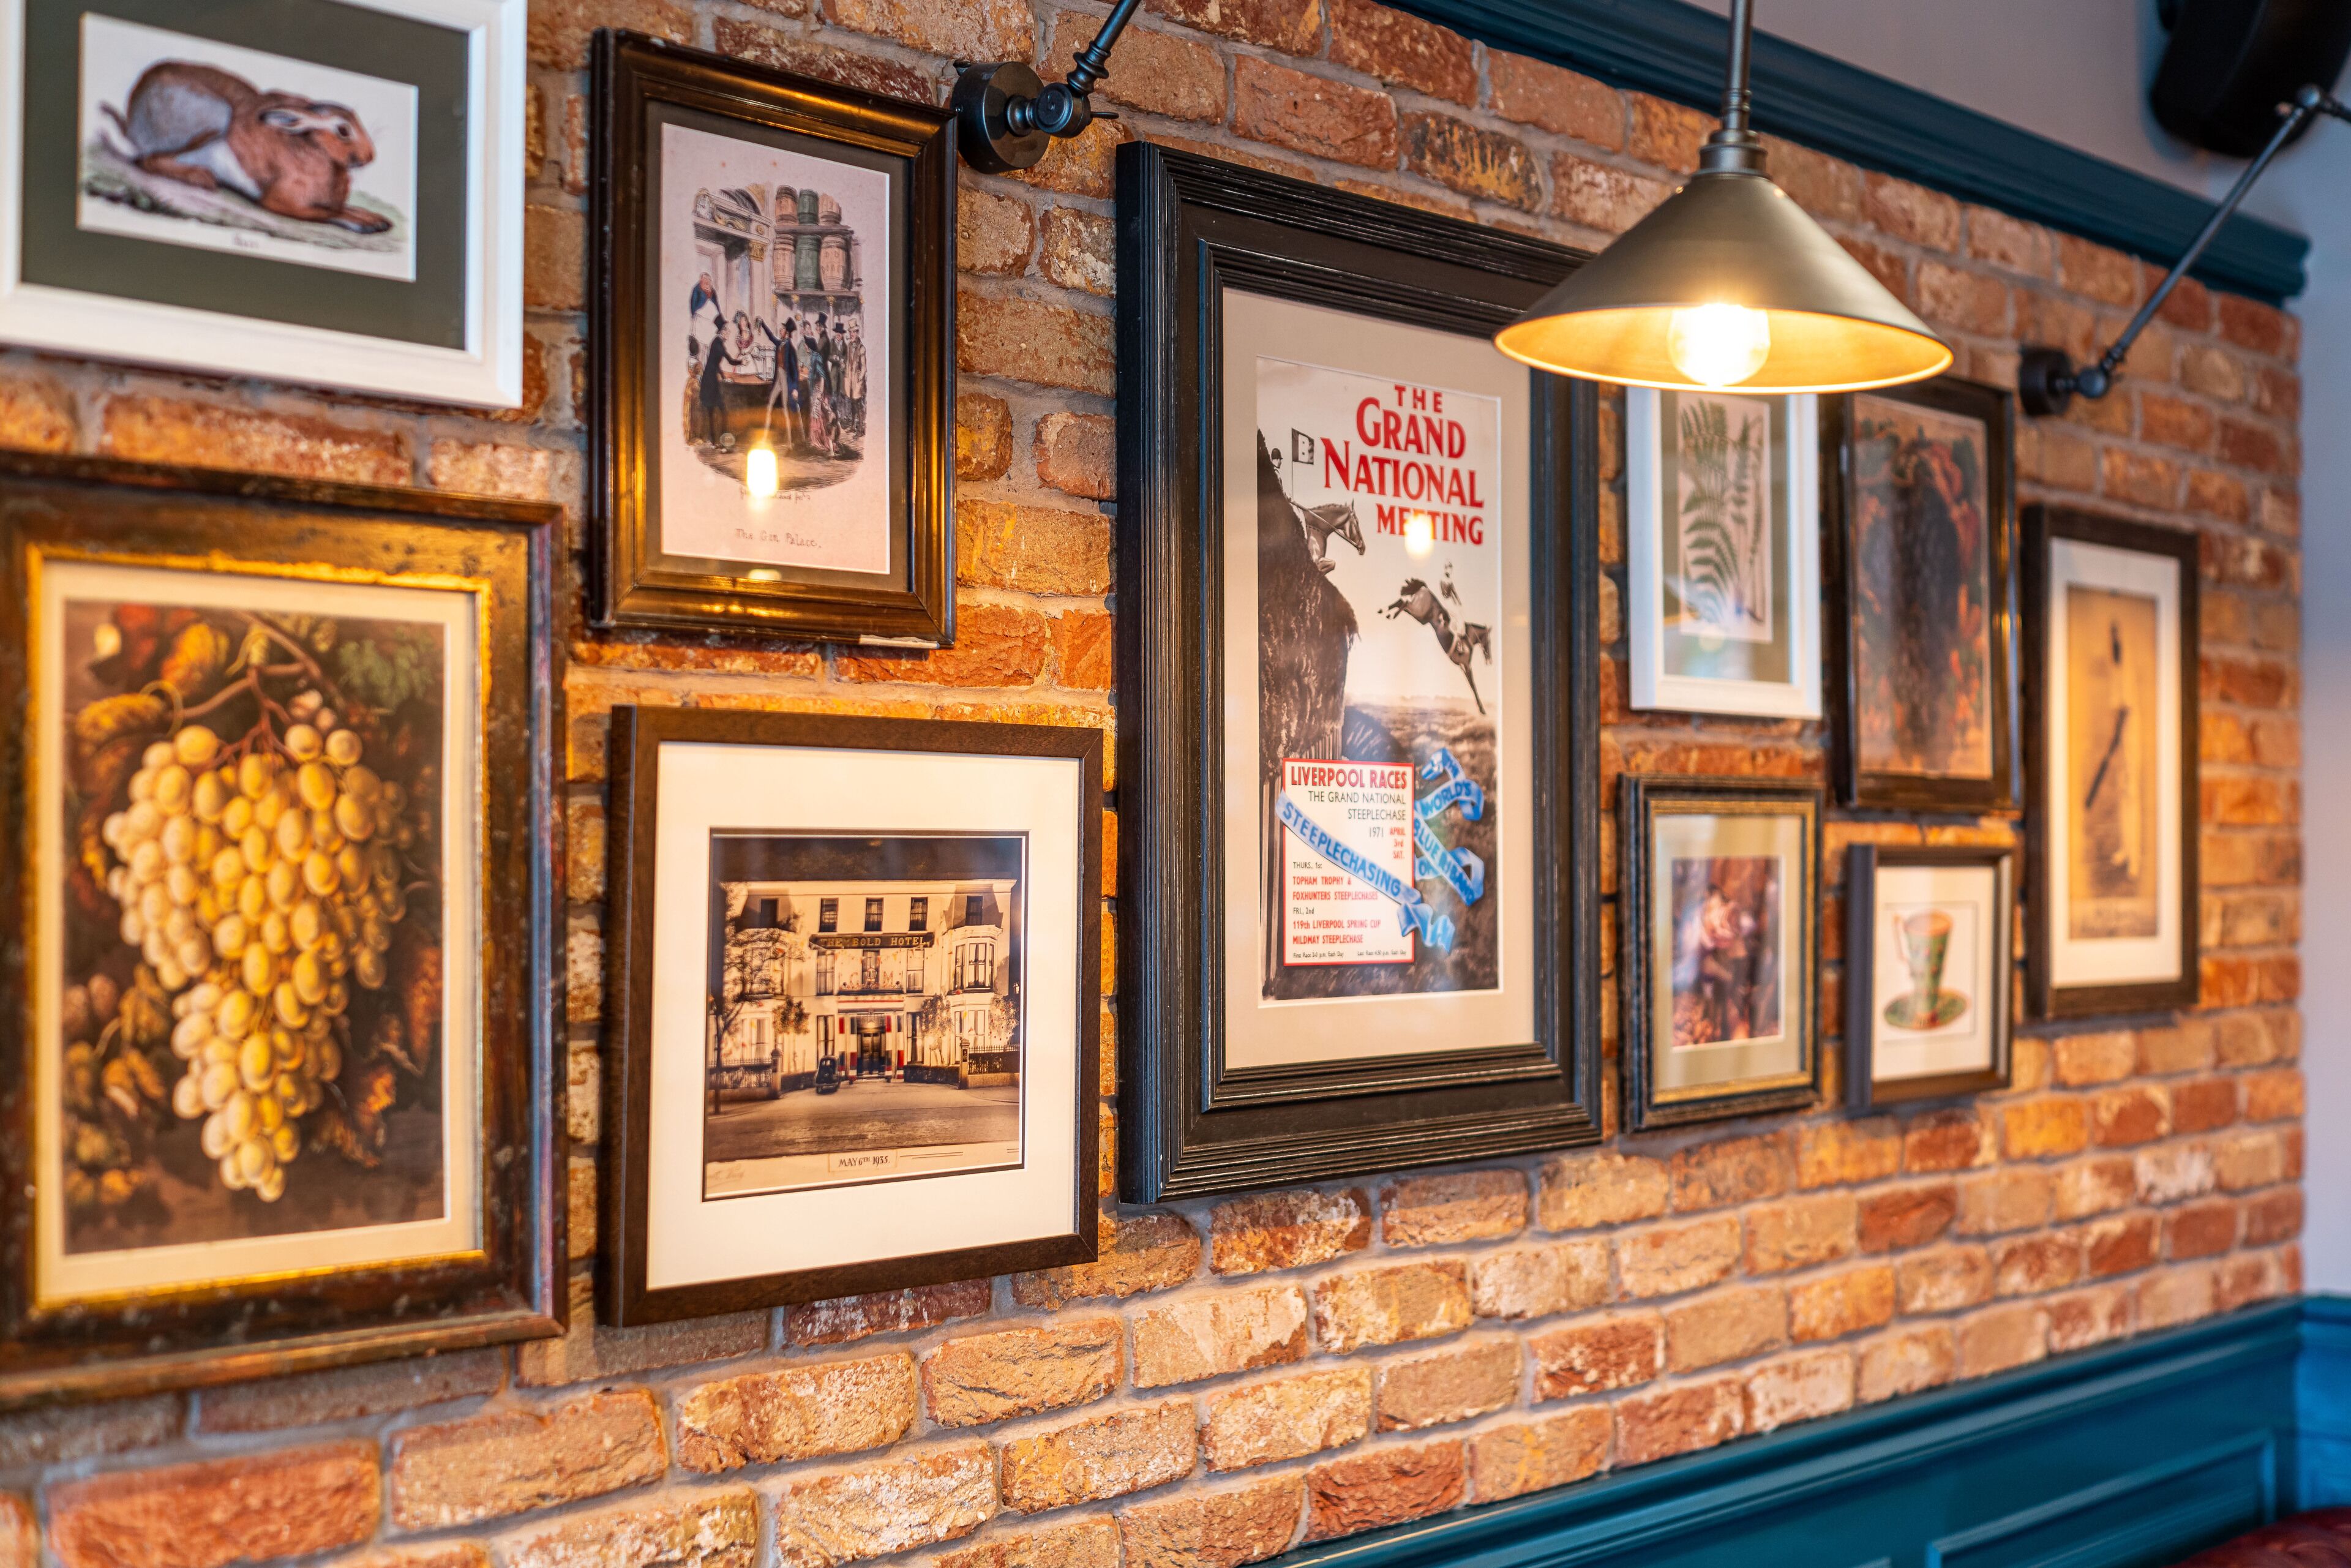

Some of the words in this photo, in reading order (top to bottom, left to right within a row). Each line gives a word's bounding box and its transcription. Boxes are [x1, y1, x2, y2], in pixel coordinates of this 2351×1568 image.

[1395, 384, 1442, 413] THE
[1356, 396, 1466, 459] GRAND
[1320, 437, 1484, 508] NATIONAL
[1291, 766, 1365, 787] LIVERPOOL
[1370, 769, 1407, 789] RACES
[1308, 790, 1325, 801] THE
[1328, 792, 1359, 803] GRAND
[1363, 793, 1406, 804] NATIONAL
[1348, 808, 1406, 820] STEEPLECHASE
[1369, 827, 1384, 838] 1971
[1390, 827, 1406, 836] APRIL
[1414, 817, 1439, 859] BLUE
[1283, 801, 1401, 897] STEEPLECHASING
[1293, 876, 1318, 885] TOPHAM
[1321, 876, 1343, 885] TROPHY
[1293, 891, 1330, 900] FOXHUNTERS
[1334, 891, 1378, 900] STEEPLECHASES
[1293, 920, 1310, 929] 119th
[1313, 920, 1344, 929] LIVERPOOL
[1347, 919, 1368, 928] SPRING
[1370, 919, 1381, 928] CUP
[852, 937, 881, 946] BOLD
[1293, 935, 1319, 944] MILDMAY
[1322, 934, 1363, 943] STEEPLECHASE
[838, 1157, 858, 1167] MAY
[872, 1155, 890, 1167] 1935.
